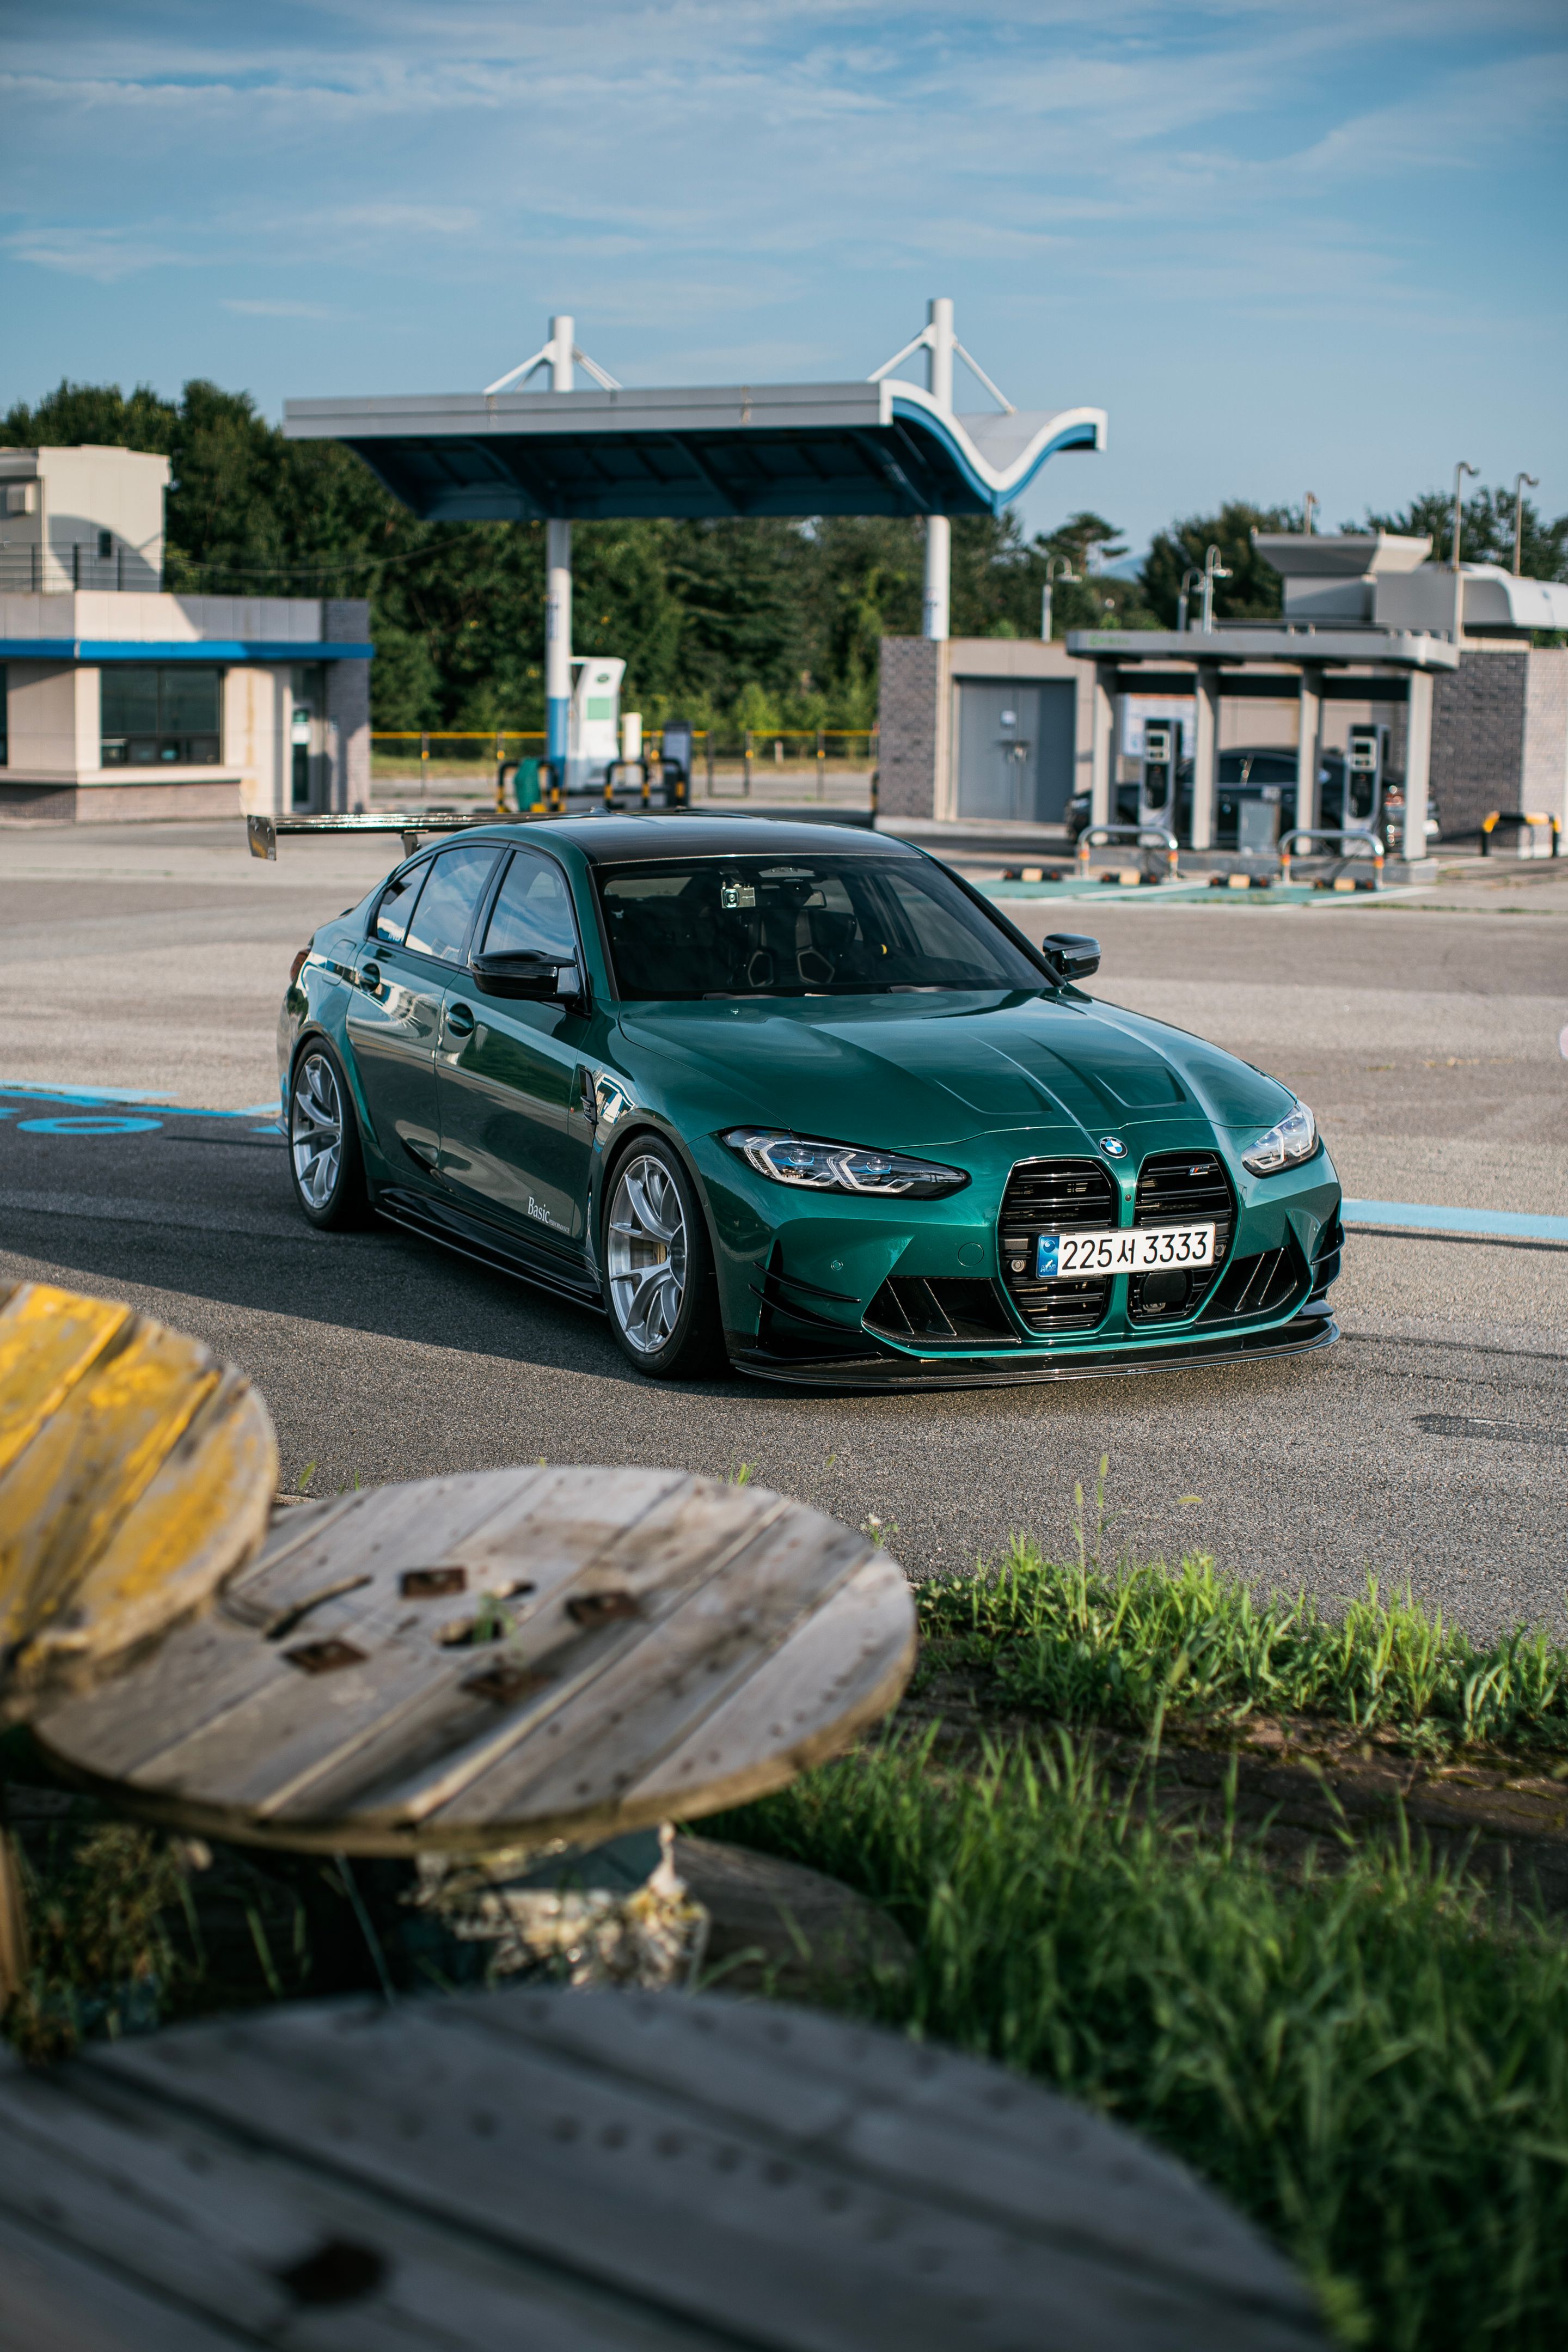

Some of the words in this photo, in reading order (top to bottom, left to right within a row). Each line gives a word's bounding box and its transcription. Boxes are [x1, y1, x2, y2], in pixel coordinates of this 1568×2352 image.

[528, 1196, 550, 1224] Basic
[548, 1219, 569, 1234] PERFORMANCE
[1143, 1231, 1208, 1264] 3333
